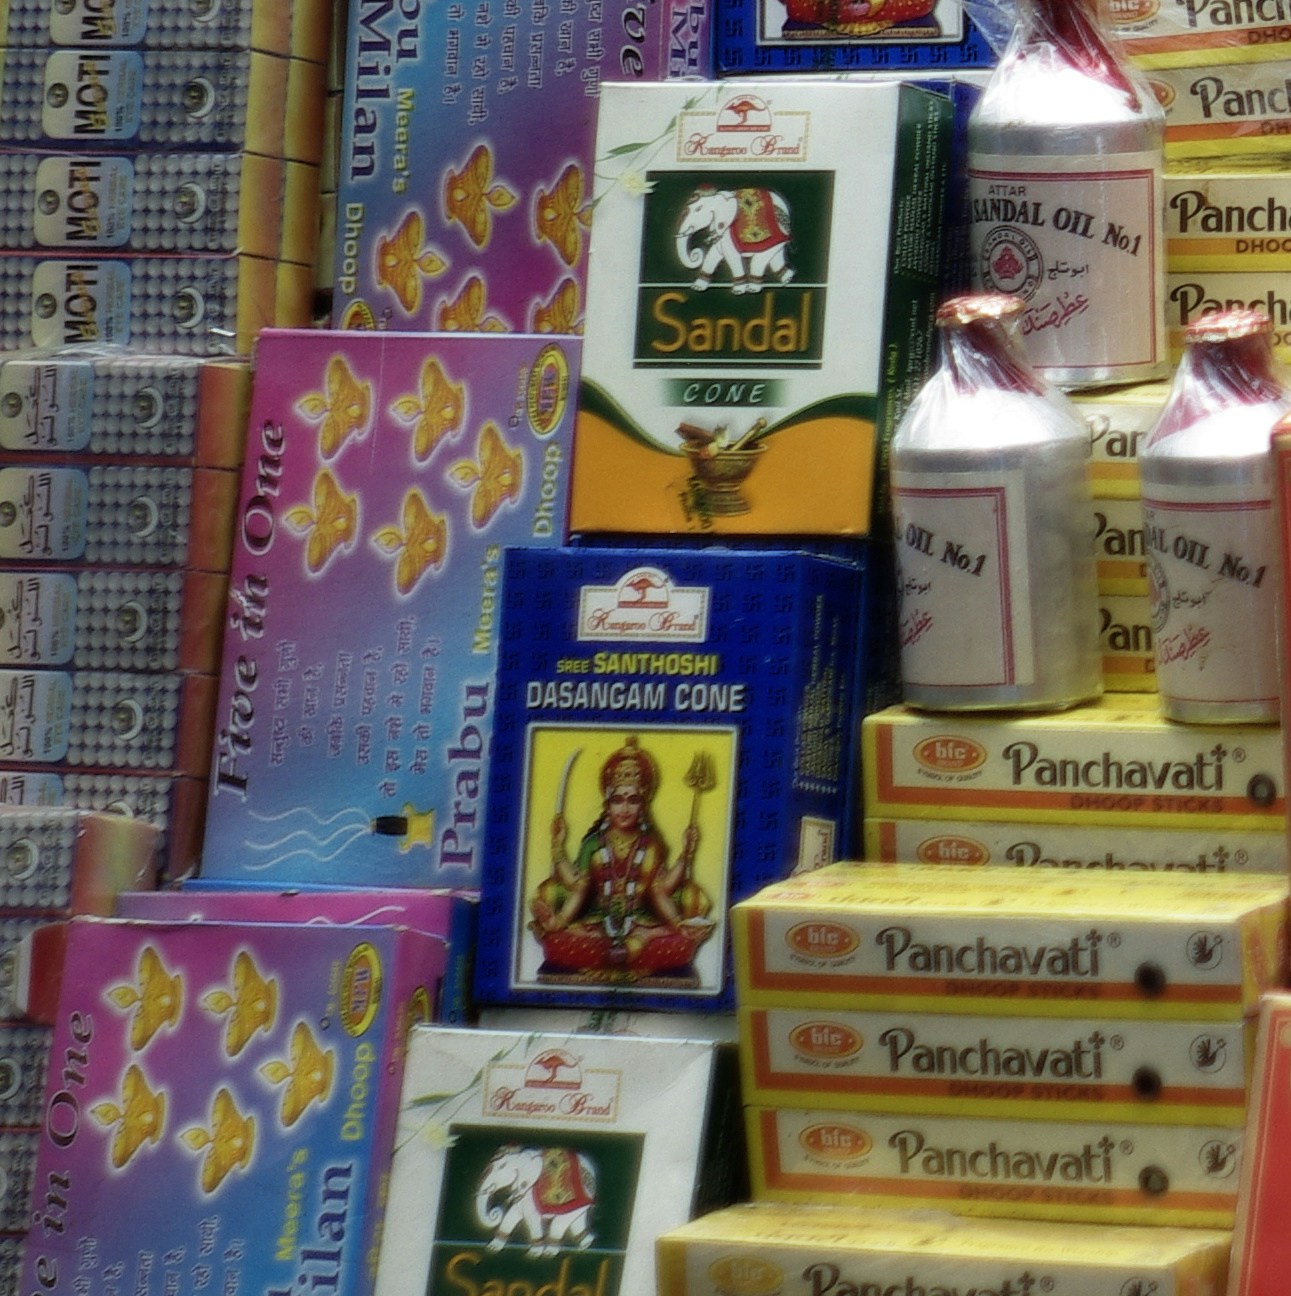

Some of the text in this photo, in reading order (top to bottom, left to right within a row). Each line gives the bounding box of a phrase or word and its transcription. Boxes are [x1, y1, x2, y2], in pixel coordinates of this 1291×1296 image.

[393, 88, 414, 194] Meera's
[683, 132, 801, 158] Kangaroo Brand
[988, 184, 1027, 197] ATTAR
[341, 203, 365, 294] Dhoop
[972, 198, 1143, 257] SANDAL OIL No.1
[650, 290, 812, 355] Sandal
[683, 381, 766, 403] CONE
[533, 443, 561, 538] Dhoop
[213, 419, 286, 802] Five in One
[472, 544, 497, 655] Meera's
[439, 681, 490, 871] Prabu
[1002, 741, 1226, 791] Panchavati
[875, 928, 1101, 978] Panchavati
